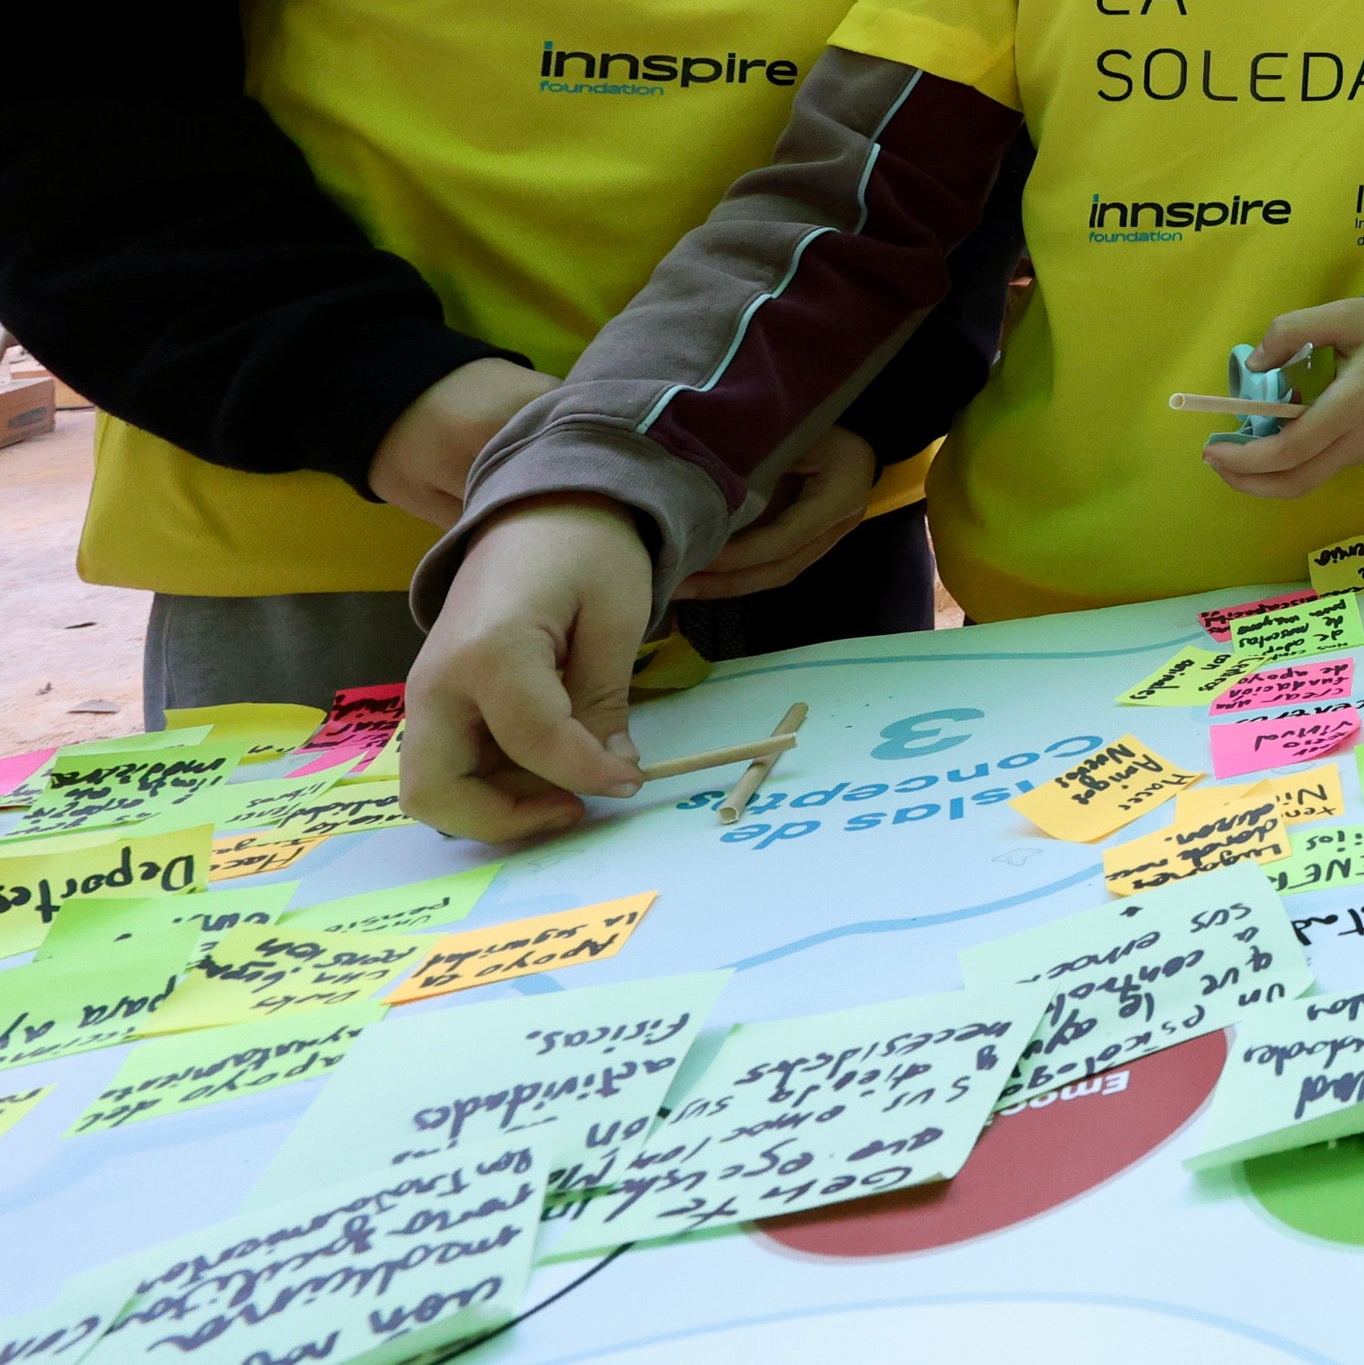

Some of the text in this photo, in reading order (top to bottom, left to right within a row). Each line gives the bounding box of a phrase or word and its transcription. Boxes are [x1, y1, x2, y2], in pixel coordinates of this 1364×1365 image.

[541, 41, 798, 86] innspire
[538, 80, 665, 96] foundation
[1089, 194, 1292, 232] innspire
[1089, 231, 1182, 243] foundation
[870, 708, 985, 760] 3
[675, 735, 1103, 815] Concepts
[720, 820, 821, 850] de
